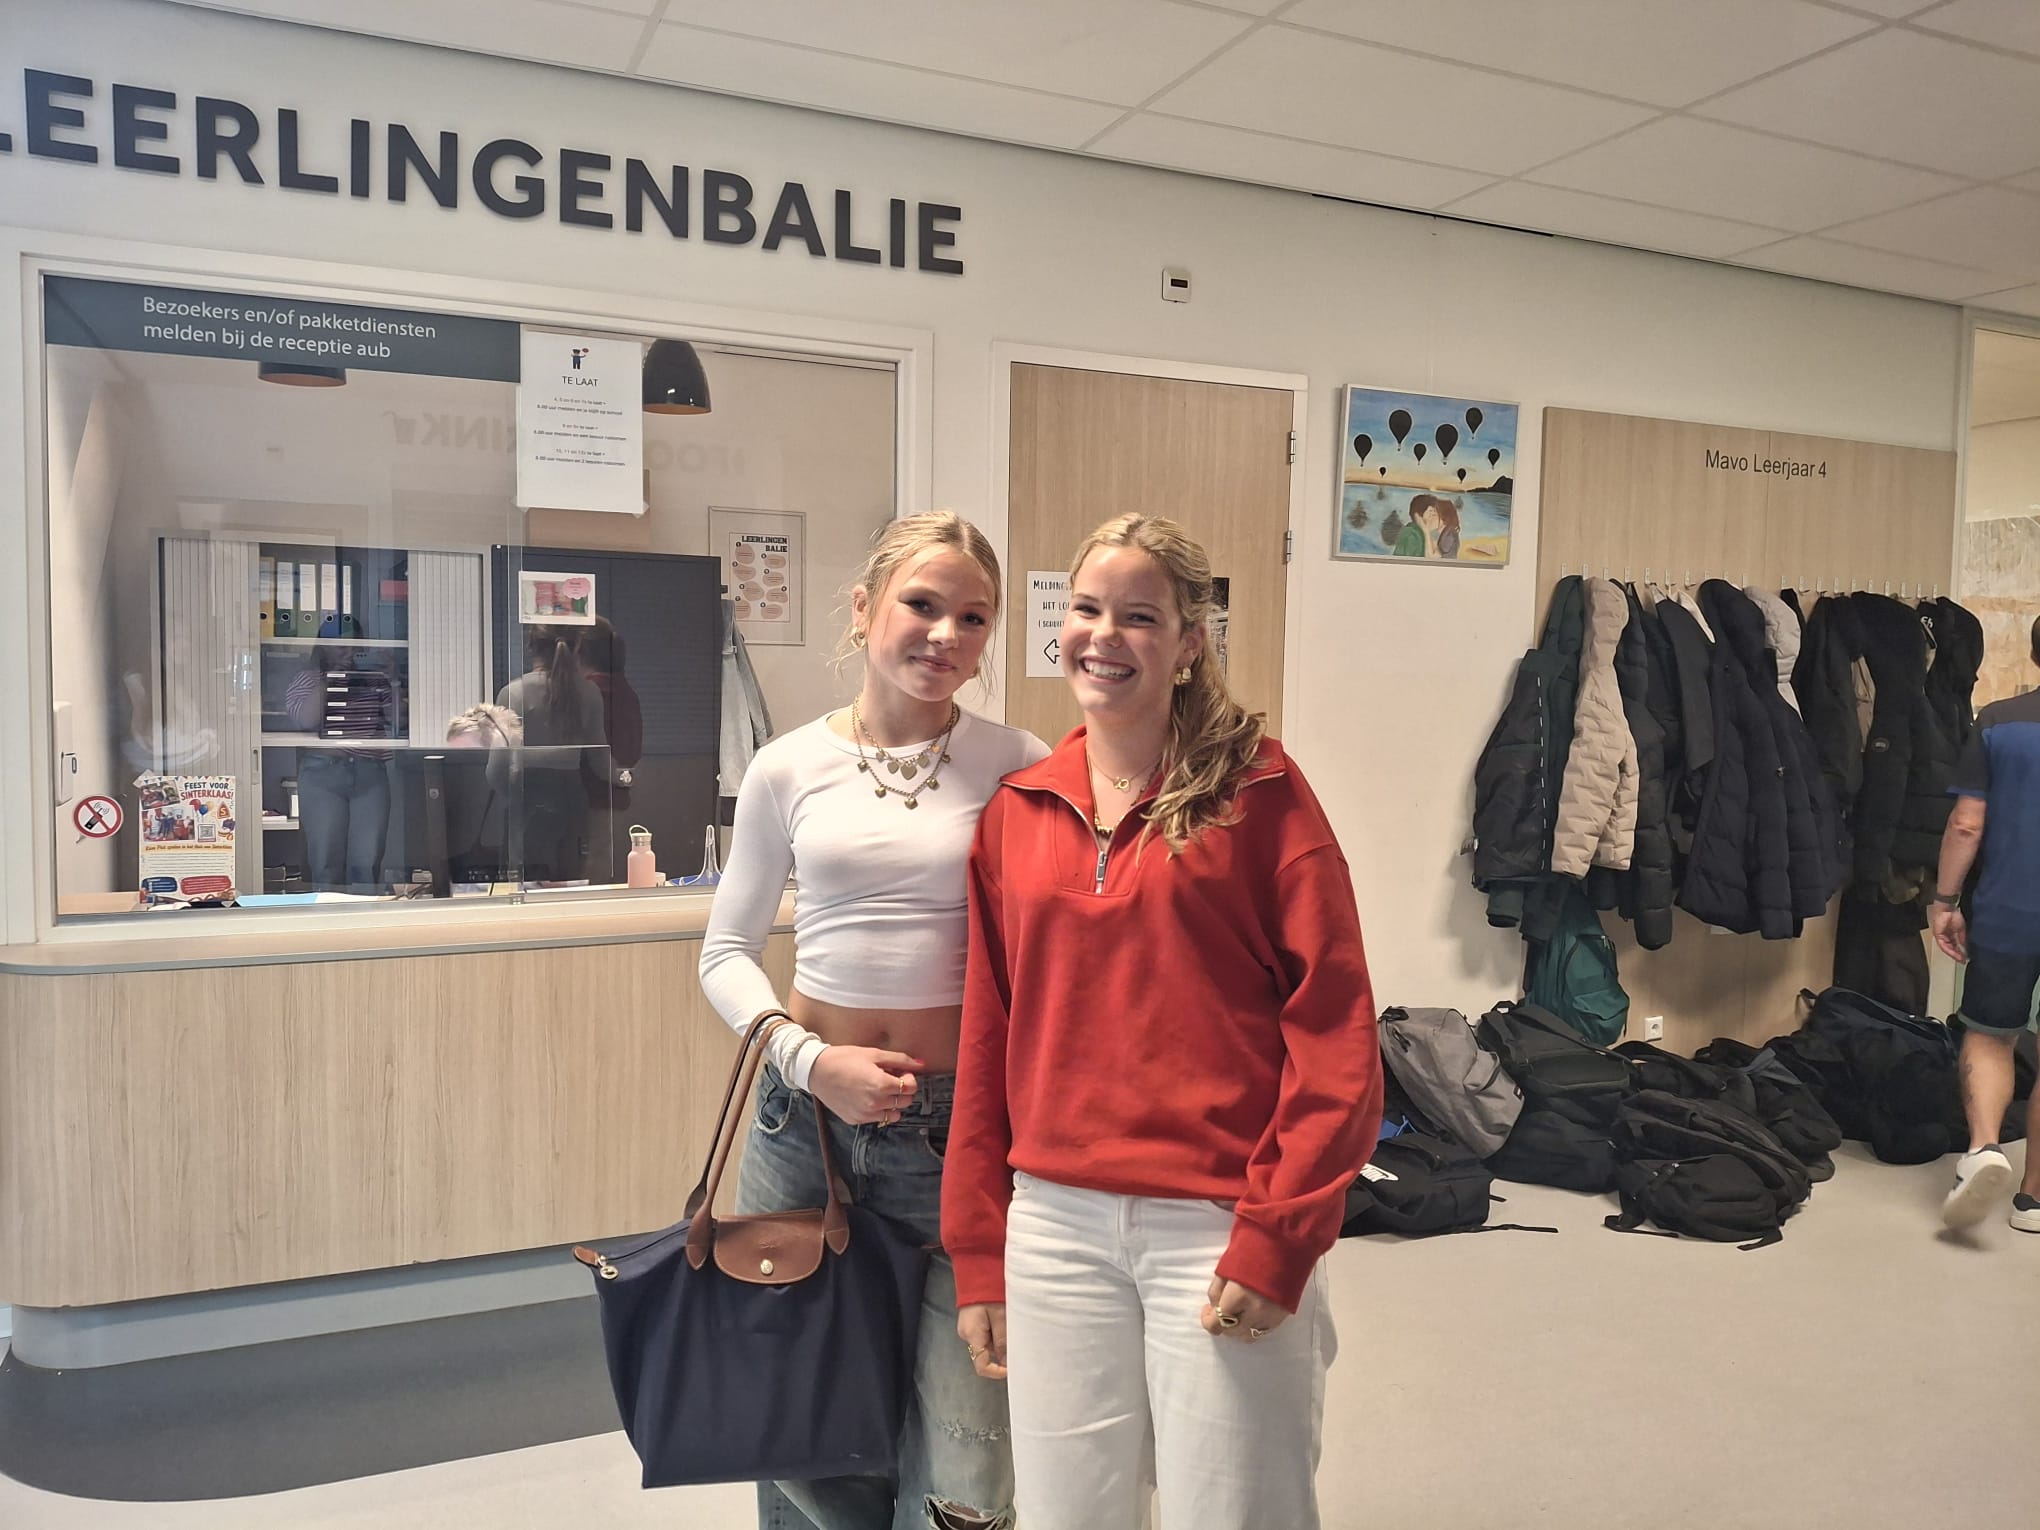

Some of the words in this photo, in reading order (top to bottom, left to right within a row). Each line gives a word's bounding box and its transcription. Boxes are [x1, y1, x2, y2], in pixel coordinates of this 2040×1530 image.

[0, 68, 963, 274] EERLINGENBALIE
[143, 296, 240, 320] Bezoekers
[244, 308, 295, 324] en/of
[299, 312, 436, 338] pakketdiensten
[143, 323, 216, 343] melden
[222, 328, 245, 349] bij
[250, 332, 274, 348] de
[279, 335, 352, 355] receptie
[357, 342, 391, 358] aub
[562, 375, 573, 385] TE
[575, 377, 598, 387] LAAT
[1705, 449, 1748, 471] Mavo
[1753, 453, 1816, 480] Leerjaar
[1818, 461, 1827, 478] 4
[741, 535, 788, 544] LEERLINGEN
[180, 790, 234, 800] SINTERKLAAS!
[184, 781, 206, 790] FEEST
